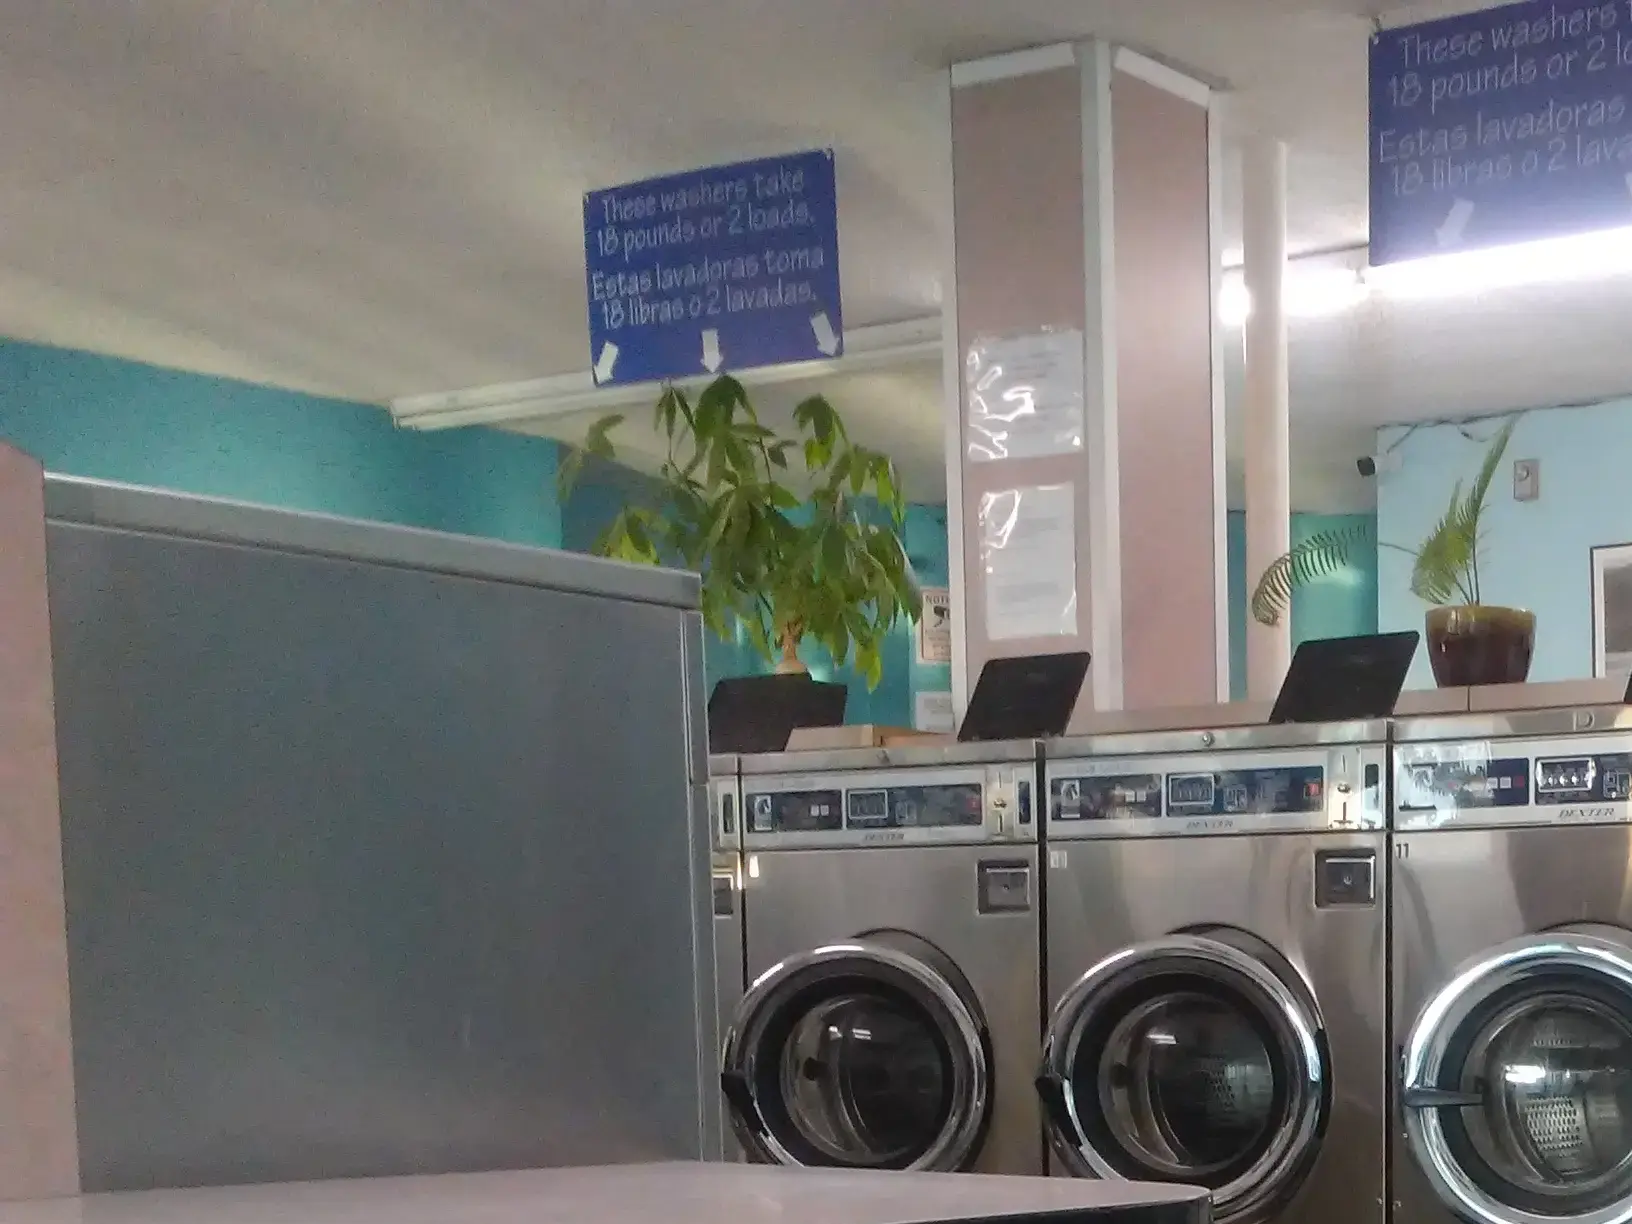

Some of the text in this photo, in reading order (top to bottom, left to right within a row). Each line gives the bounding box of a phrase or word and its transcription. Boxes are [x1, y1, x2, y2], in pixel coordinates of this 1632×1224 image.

[1399, 32, 1485, 67] These
[1491, 3, 1618, 51] washers
[1388, 74, 1423, 108] 18
[1432, 52, 1540, 116] pounds
[1547, 51, 1580, 80] or
[1587, 35, 1608, 73] 2
[1379, 126, 1469, 164] Estas
[1477, 97, 1627, 148] lavadoras
[603, 164, 804, 223] These washers take
[1393, 163, 1425, 198] 18
[1433, 155, 1513, 192] libras
[1549, 139, 1570, 175] 2
[597, 230, 620, 256] 18
[624, 215, 695, 262] pounds
[700, 216, 722, 238] or
[728, 204, 746, 235] 2
[592, 247, 825, 301] Estas lavadoras toma
[602, 302, 625, 331] 18
[629, 297, 684, 327] libras
[706, 289, 722, 317] 2
[1395, 843, 1409, 859] 11
